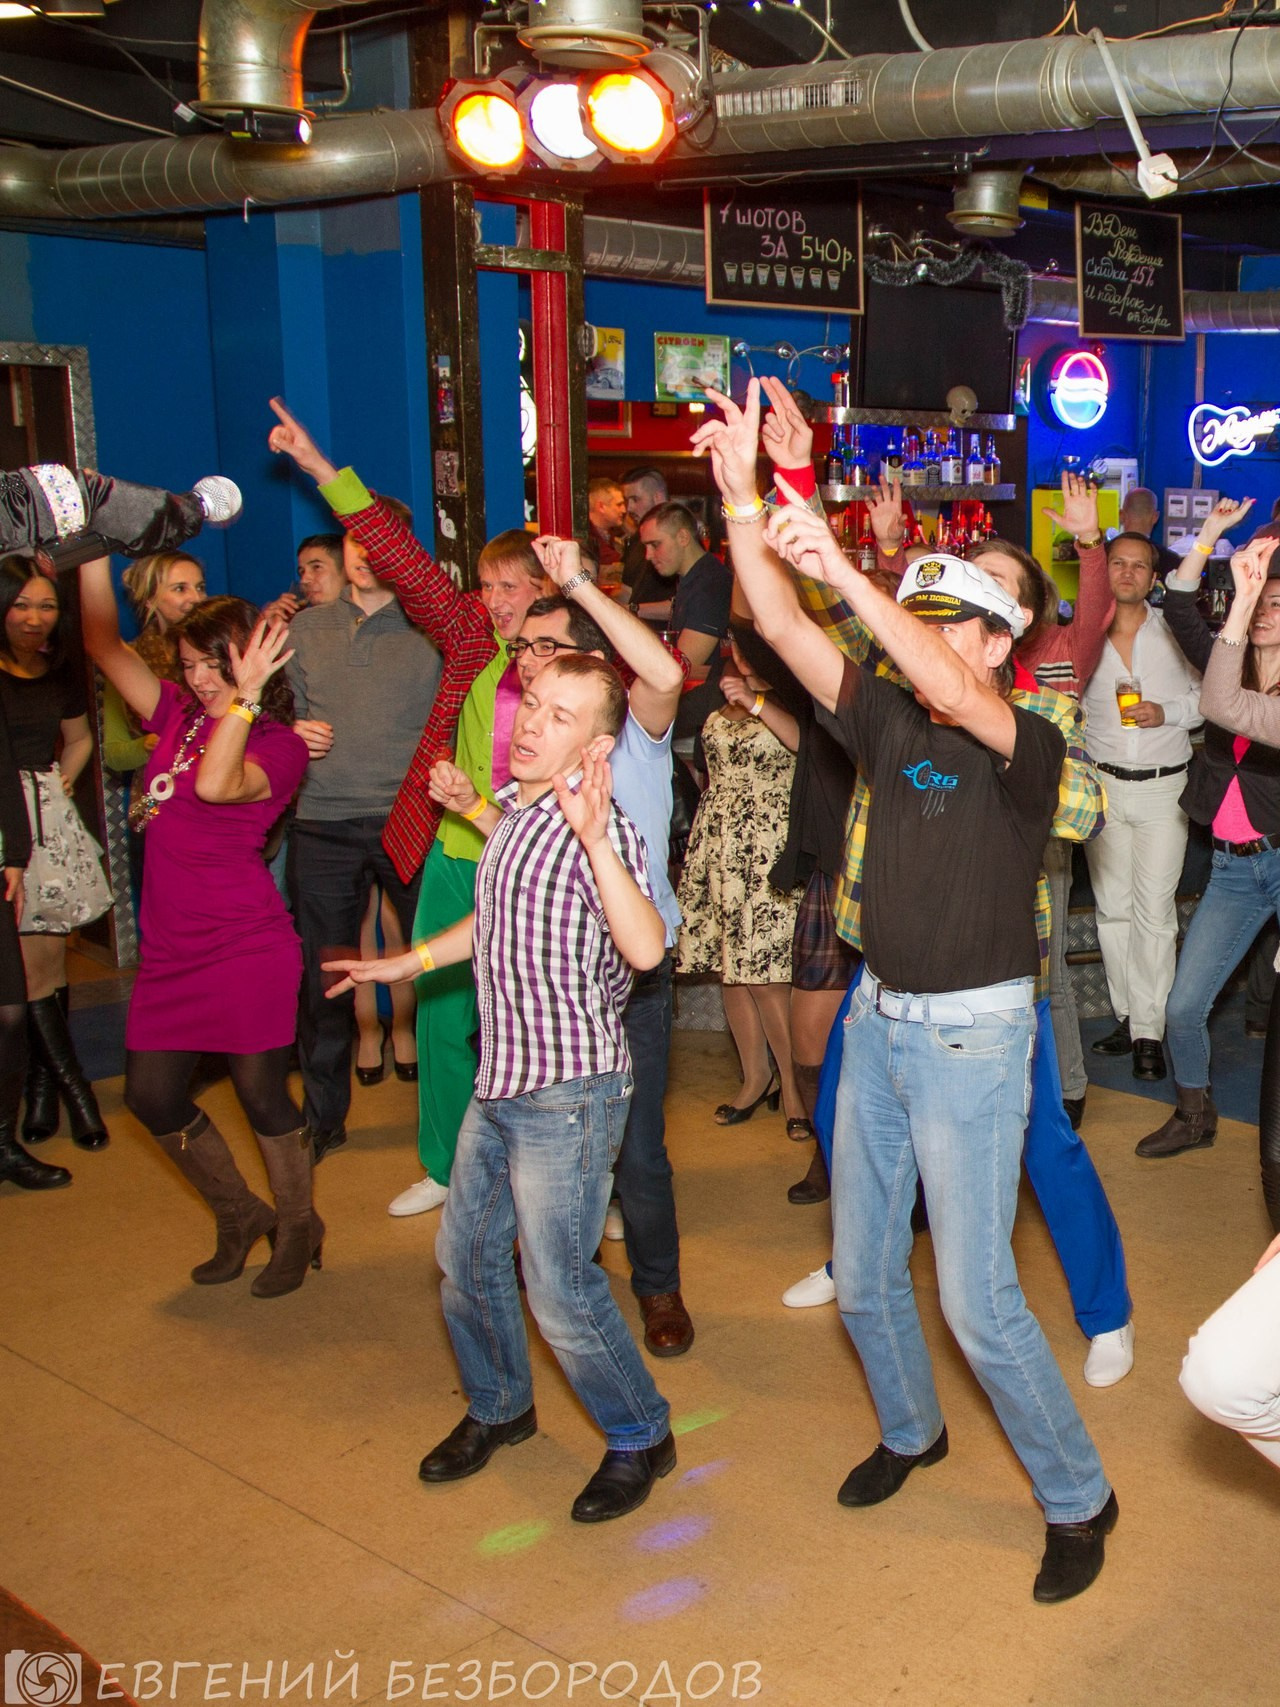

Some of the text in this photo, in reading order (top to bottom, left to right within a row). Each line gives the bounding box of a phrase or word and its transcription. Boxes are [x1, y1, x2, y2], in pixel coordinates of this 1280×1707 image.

[736, 208, 806, 235] ШОТОВ
[760, 234, 789, 259] ЗА
[1085, 256, 1155, 286] Скидка 15%
